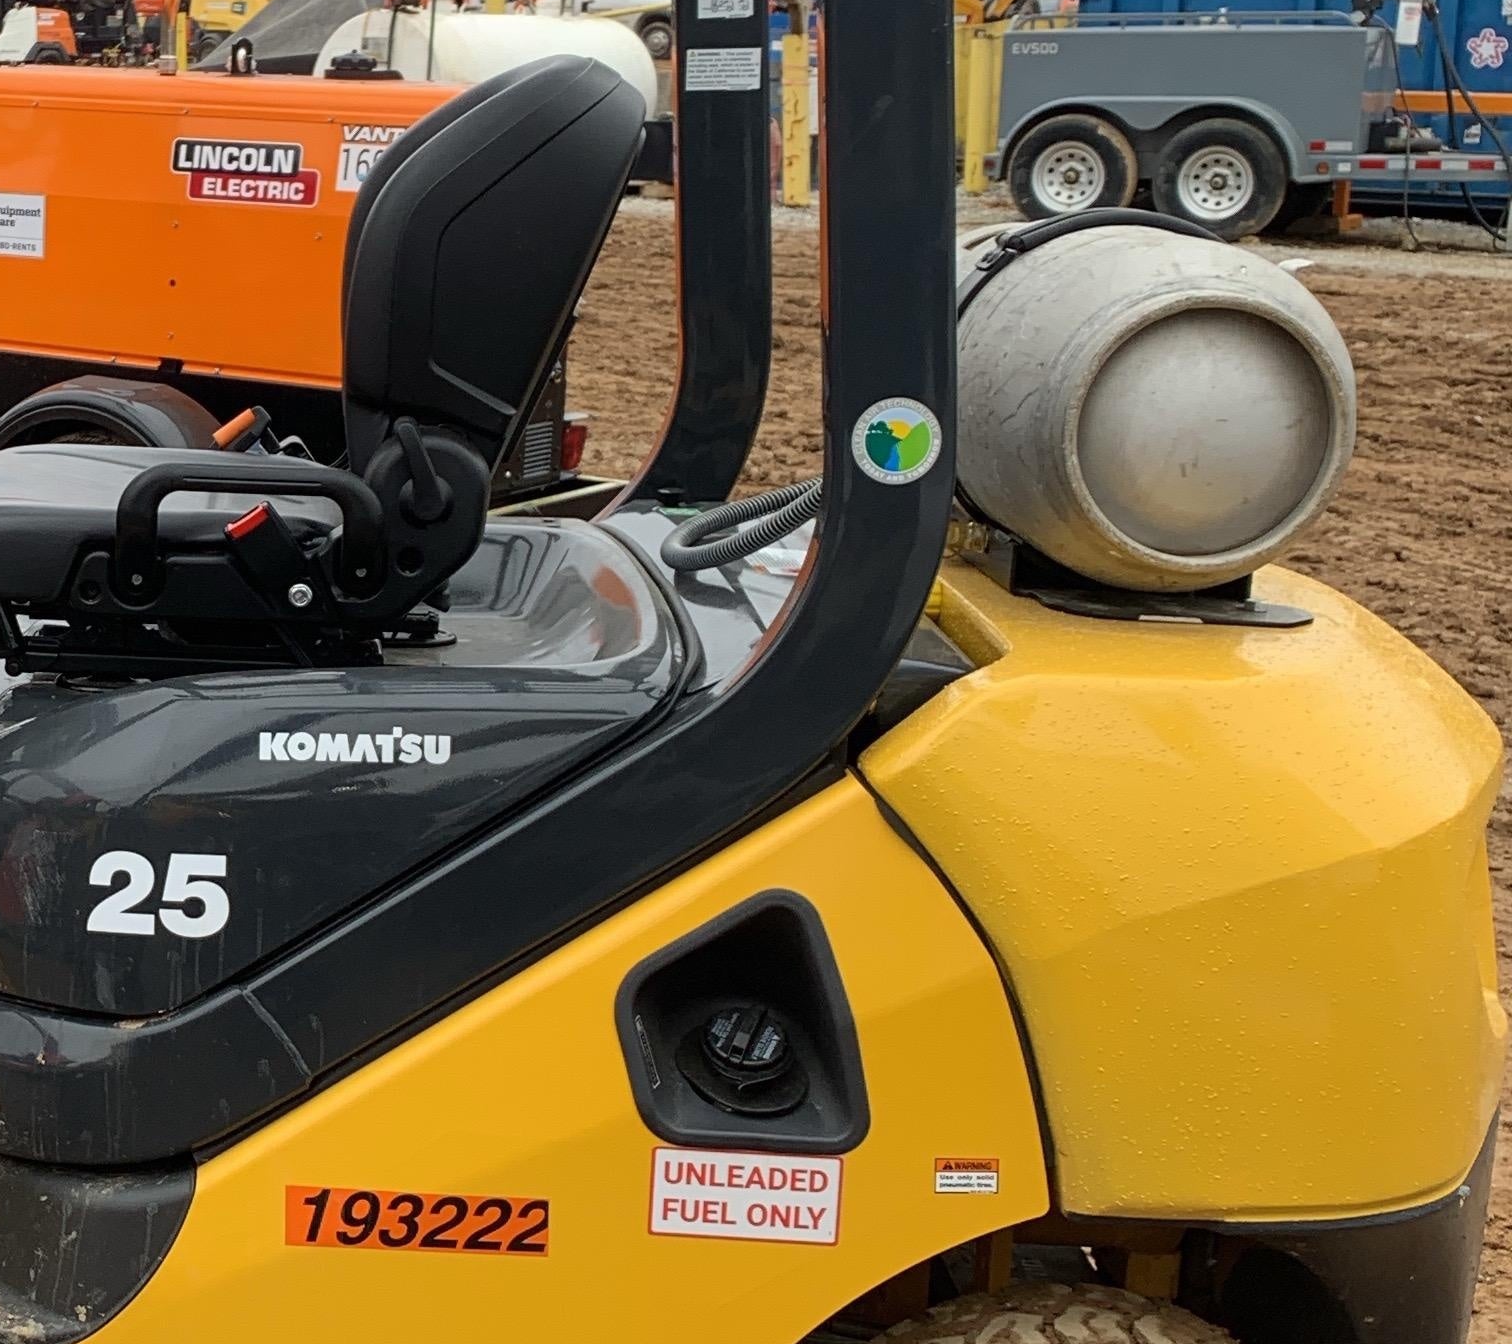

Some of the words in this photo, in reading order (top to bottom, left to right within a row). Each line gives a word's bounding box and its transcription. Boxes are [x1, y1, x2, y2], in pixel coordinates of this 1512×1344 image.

[1011, 42, 1059, 55] EV500
[178, 144, 296, 175] LINCOLN
[202, 177, 306, 201] ELECTRIC
[258, 726, 451, 765] KOMATSU
[86, 850, 230, 938] 25
[663, 1160, 829, 1193] UNLEADED
[954, 1161, 993, 1170] WARNING
[957, 1174, 973, 1182] only
[302, 1187, 550, 1254] 193222
[661, 1197, 737, 1226] FUEL
[746, 1202, 828, 1230] ONLY
